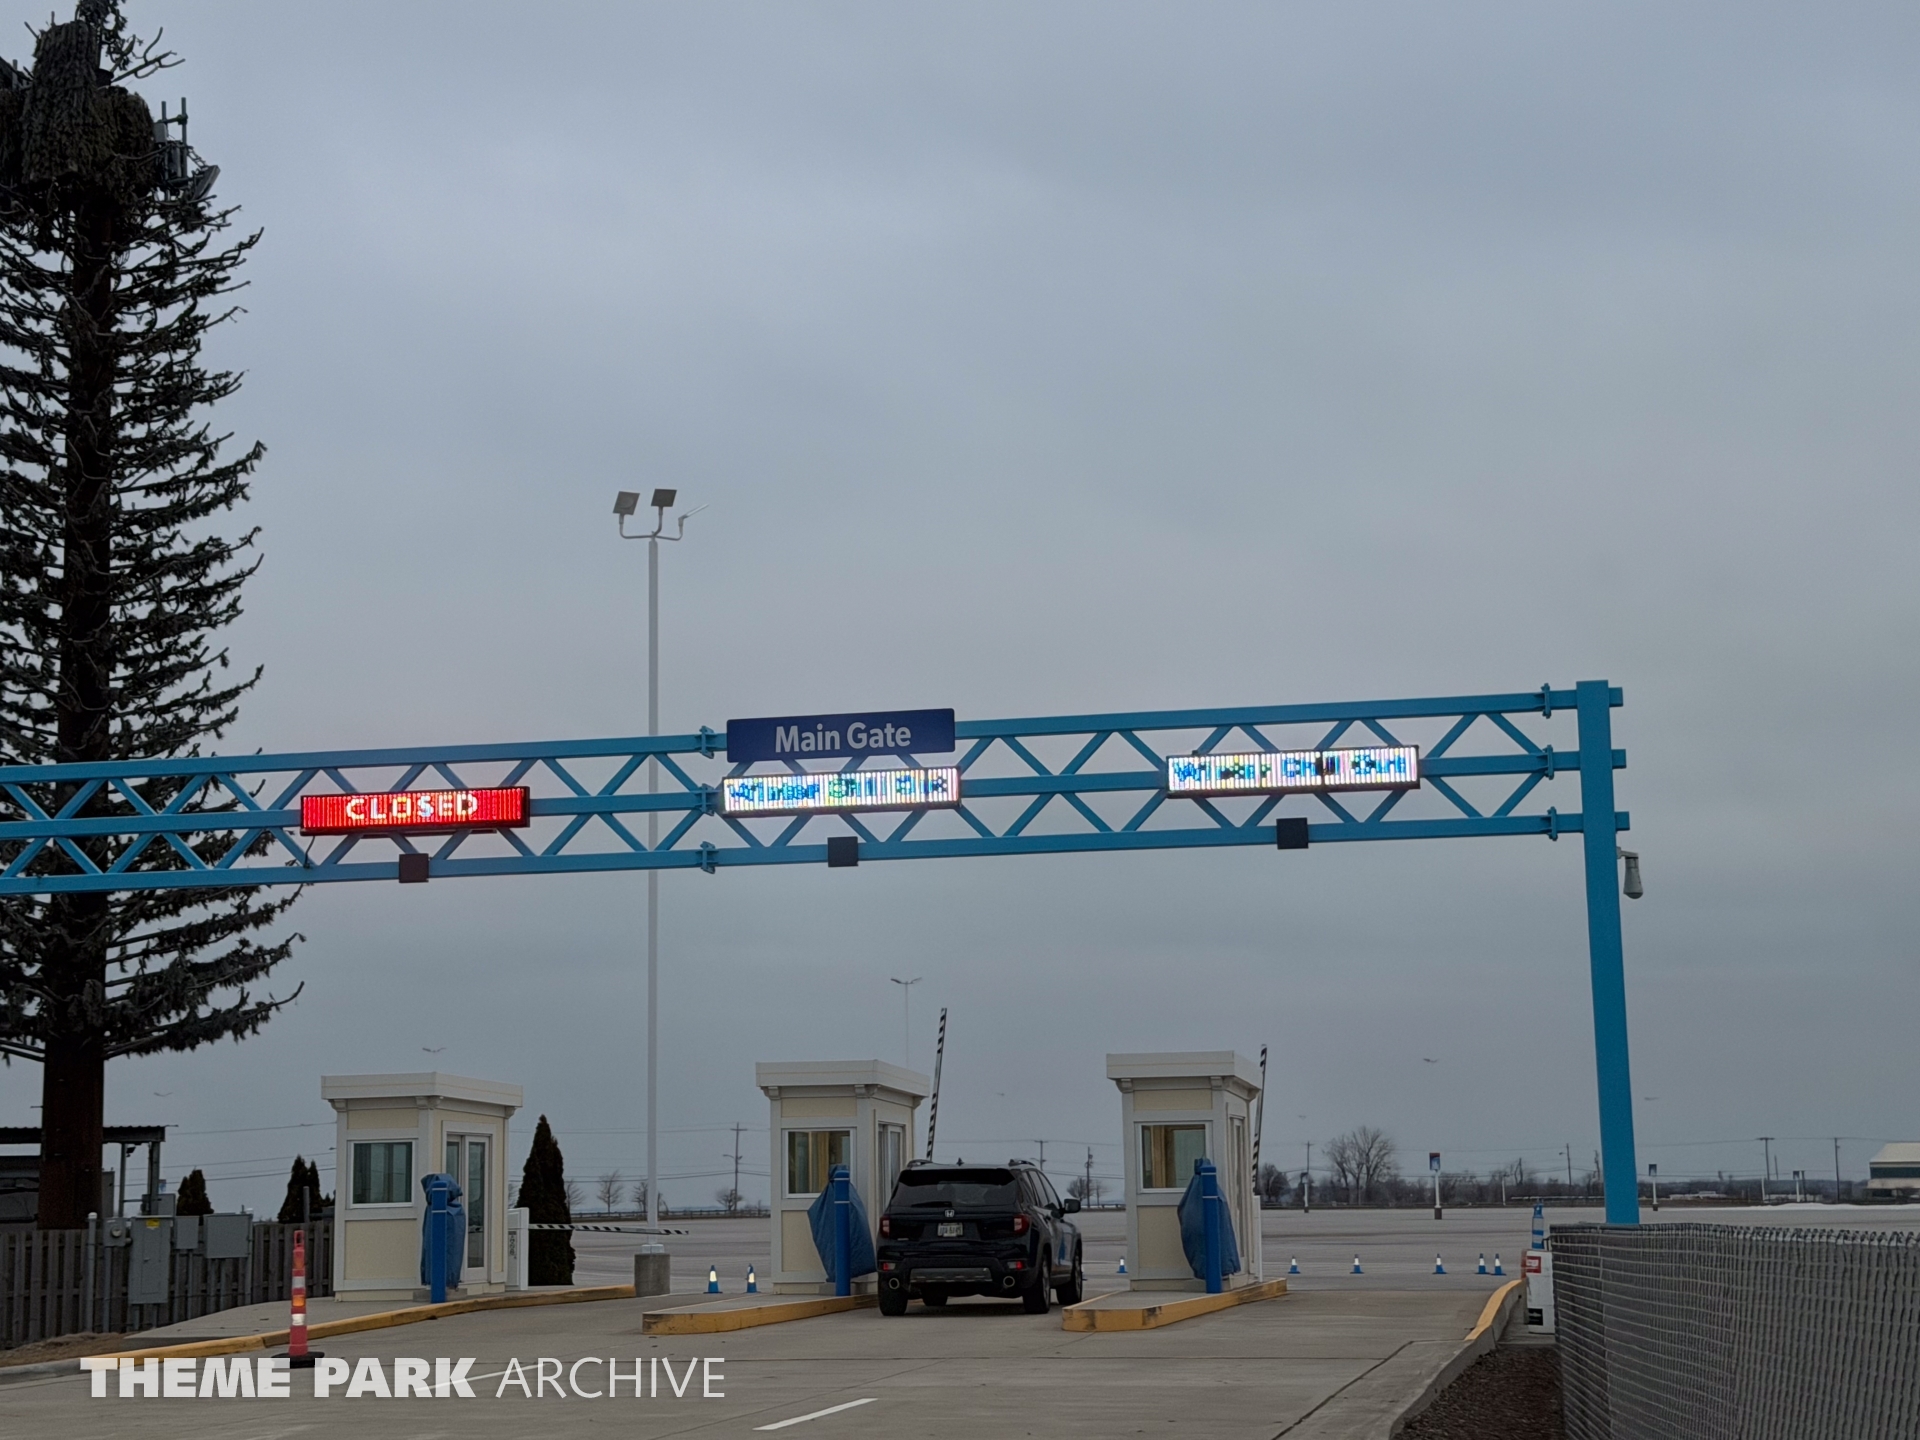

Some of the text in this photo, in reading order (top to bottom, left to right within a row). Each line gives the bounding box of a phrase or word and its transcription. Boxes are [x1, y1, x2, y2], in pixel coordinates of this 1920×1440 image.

[775, 721, 911, 753] Main Gate
[346, 793, 478, 820] CLOSED
